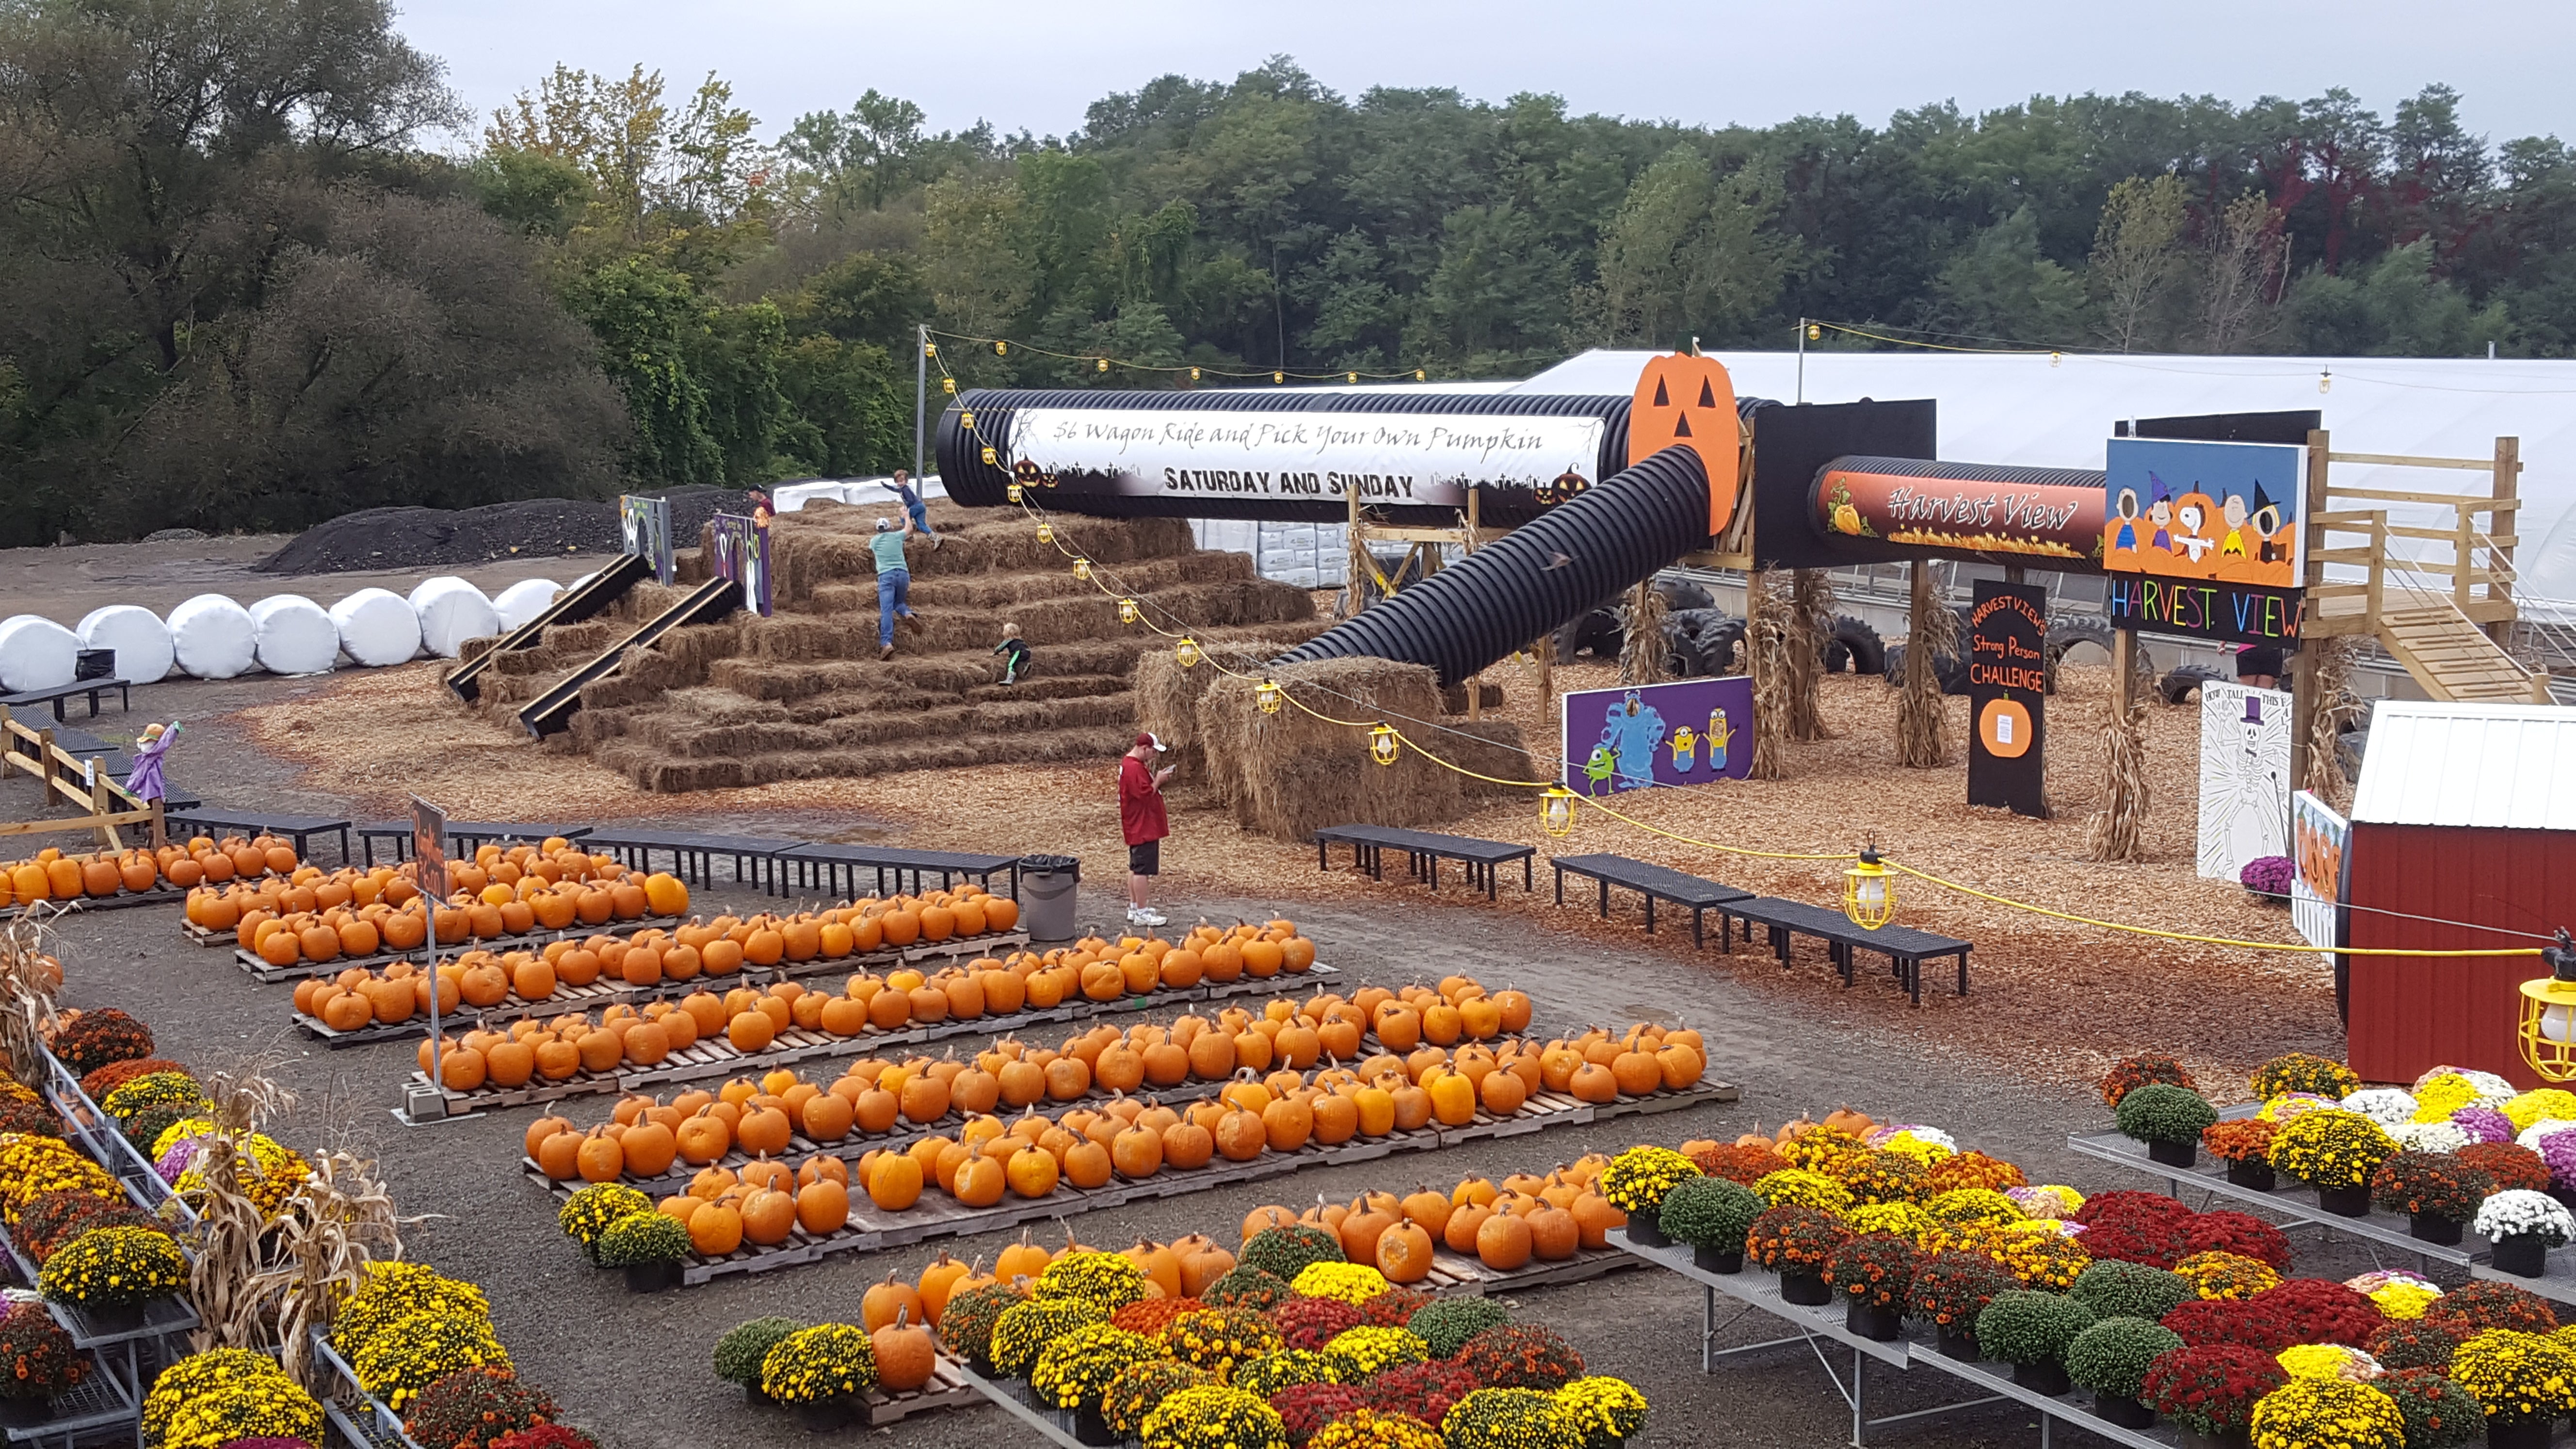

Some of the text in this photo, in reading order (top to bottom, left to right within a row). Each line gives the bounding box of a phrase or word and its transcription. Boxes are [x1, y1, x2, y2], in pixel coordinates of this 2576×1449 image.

[1054, 420, 1543, 465] $6 Wagon Ride and Pick Your Own Pumpkin
[1164, 467, 1413, 498] SATURDAY AND SUNDAY
[1888, 486, 2078, 531] Harvest View
[2112, 580, 2302, 638] HARVEST VIEW
[1973, 634, 2040, 660] Strong Person
[1970, 662, 2044, 693] CHALLENGE
[2205, 689, 2221, 702] HOW
[2262, 694, 2279, 706] THIS
